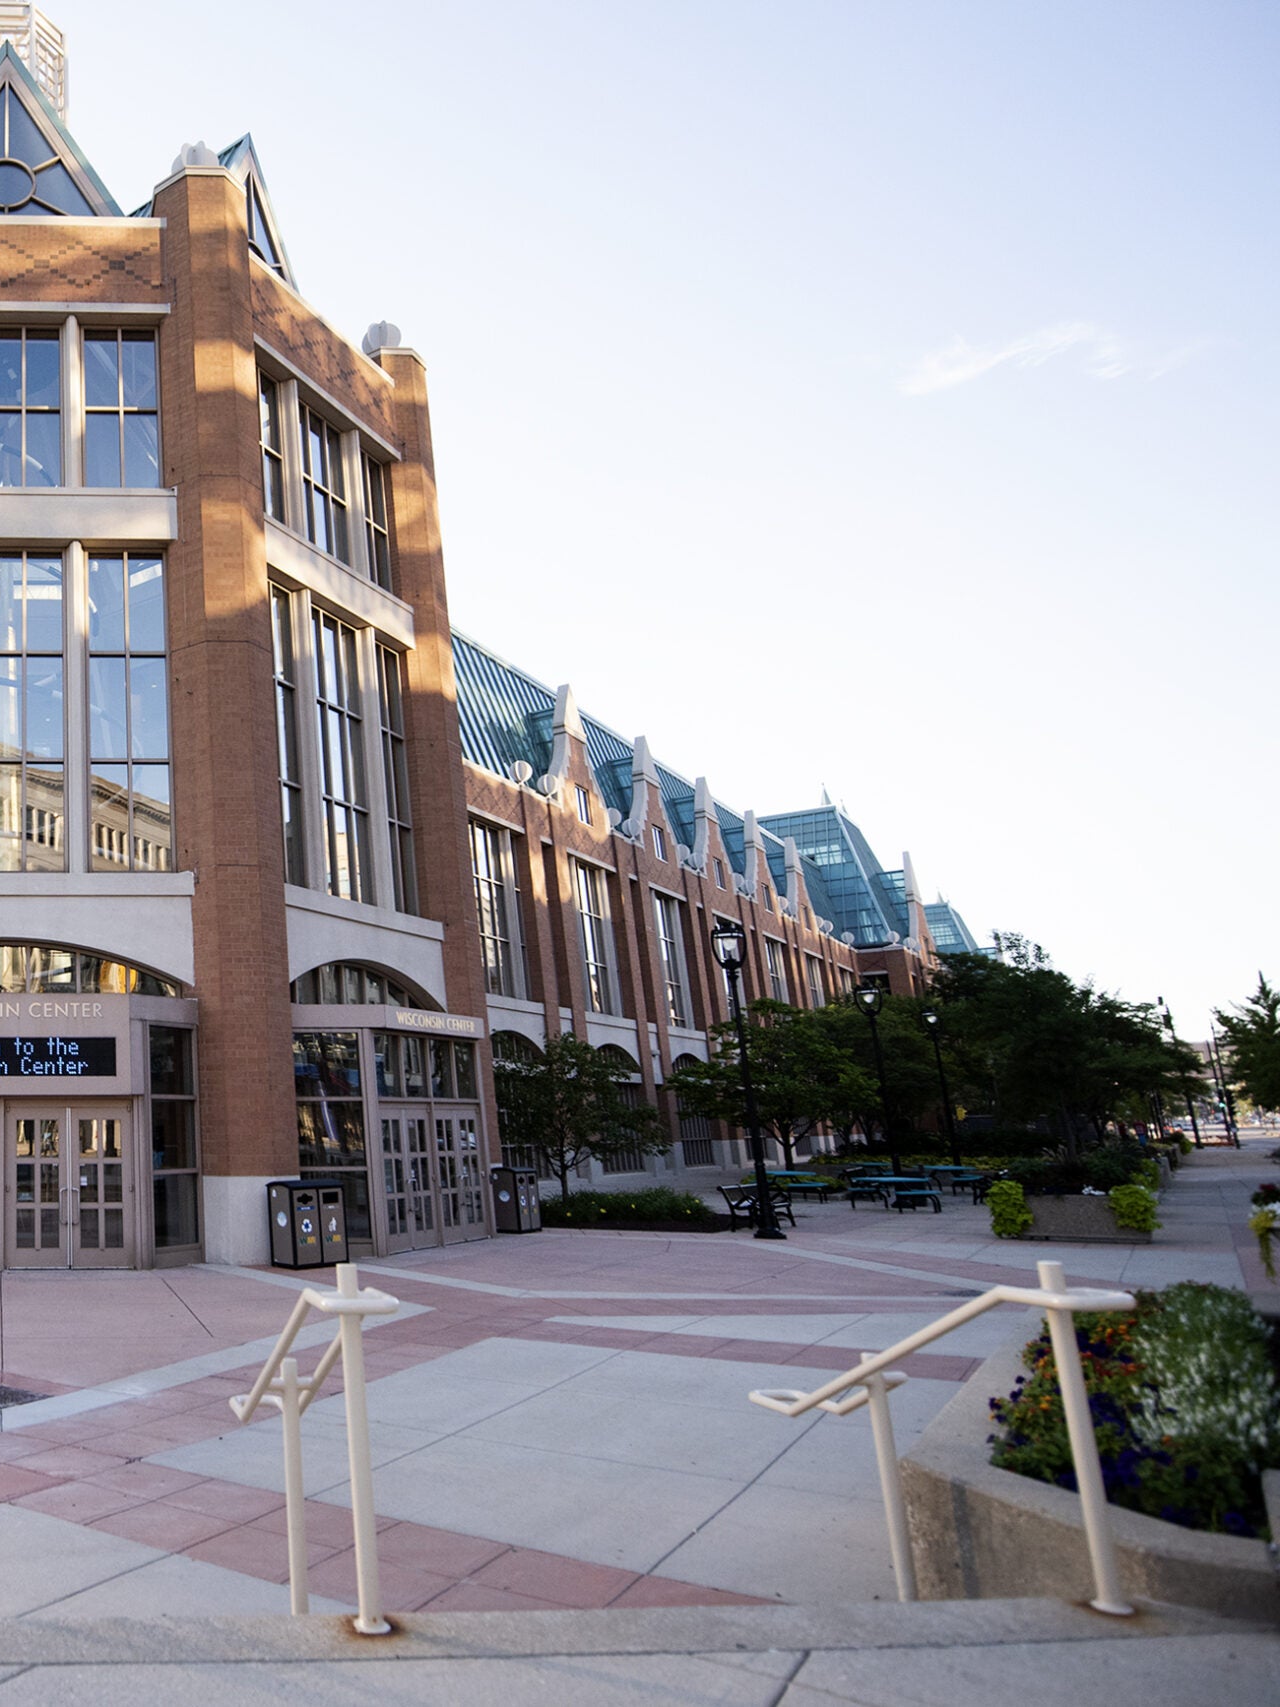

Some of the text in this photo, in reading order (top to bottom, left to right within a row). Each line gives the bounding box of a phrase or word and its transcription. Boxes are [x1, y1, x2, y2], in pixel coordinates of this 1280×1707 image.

[28, 1002, 103, 1018] CENTER
[396, 1011, 475, 1033] WISCONSIN CENTER
[14, 1037, 35, 1055] to
[47, 1037, 80, 1055] the
[20, 1057, 89, 1075] Center
